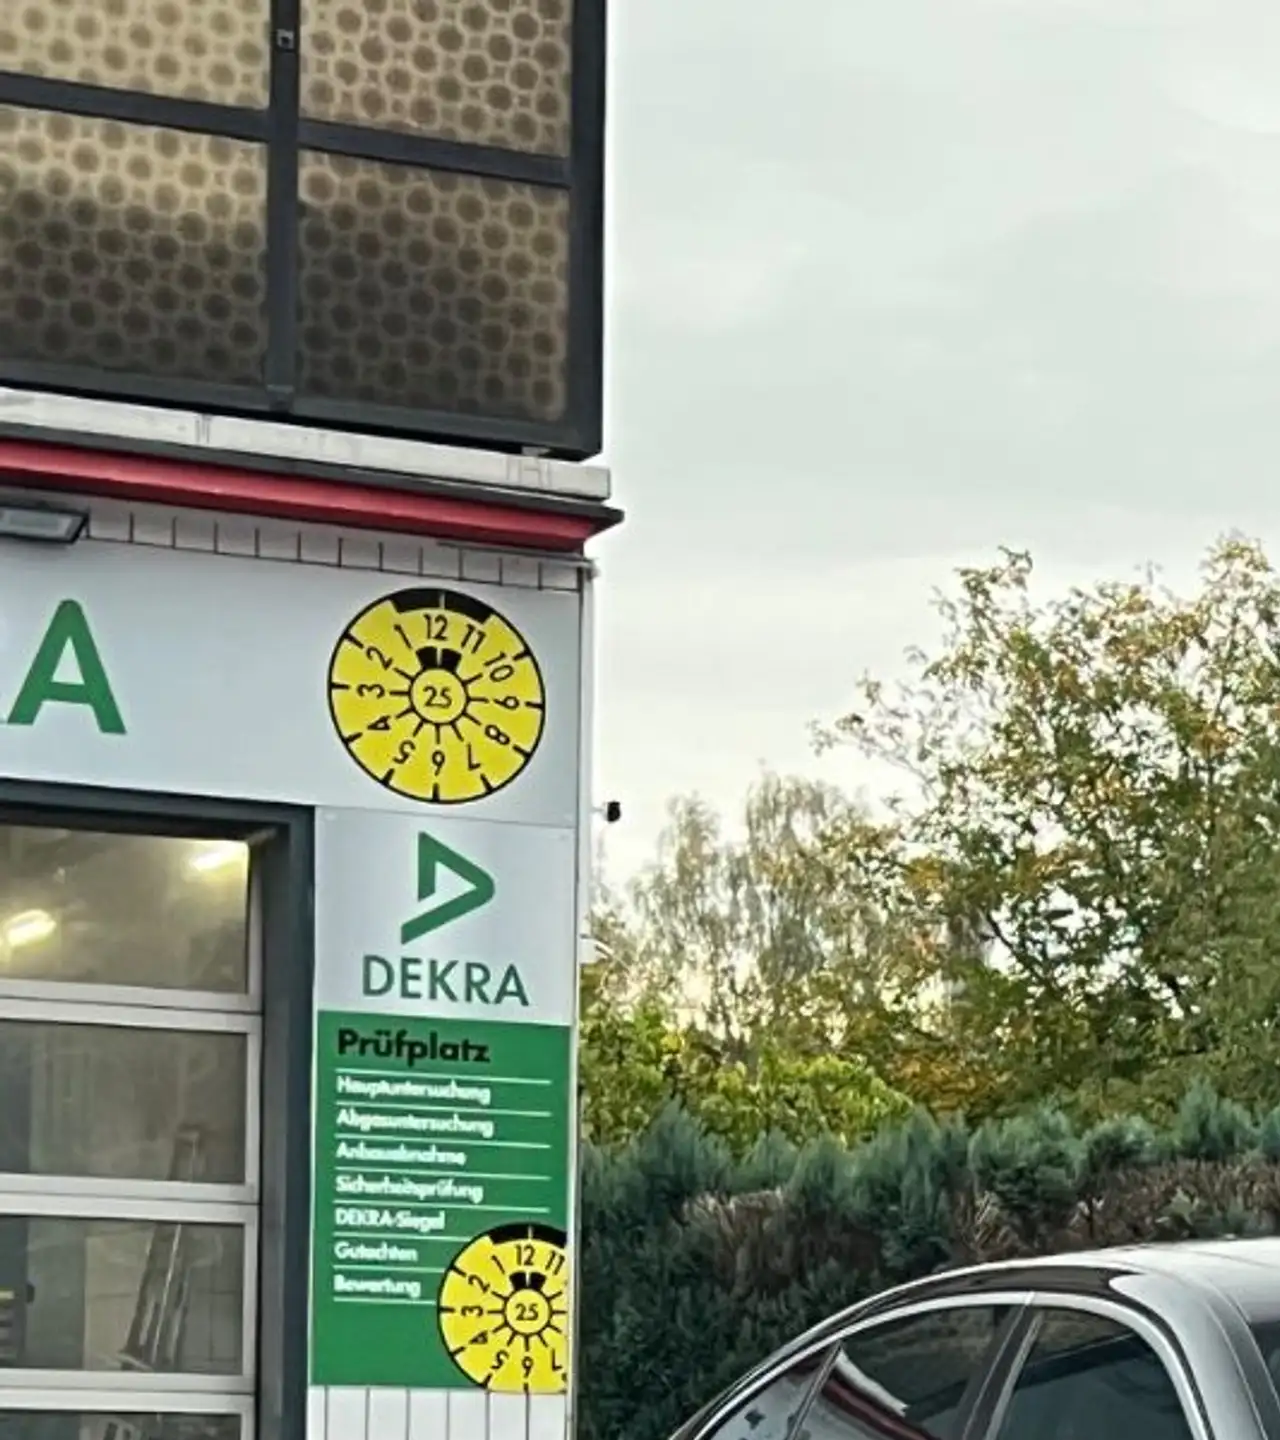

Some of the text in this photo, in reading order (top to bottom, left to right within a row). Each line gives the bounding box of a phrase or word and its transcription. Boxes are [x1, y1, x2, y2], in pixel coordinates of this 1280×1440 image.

[394, 624, 413, 649] 1
[424, 614, 448, 640] 12
[461, 624, 486, 654] 11
[0, 598, 127, 734] A
[366, 647, 393, 670] 2
[484, 652, 514, 682] 10
[357, 684, 385, 699] 3
[423, 686, 452, 708] 25
[493, 696, 519, 709] 9
[367, 715, 391, 730] 4
[484, 725, 510, 745] 8
[392, 740, 416, 764] 5
[466, 743, 480, 770] 7
[363, 954, 529, 1006] DEKRA
[338, 1028, 491, 1067] Prüfplatz
[336, 1075, 491, 1105] Hauptuntersuchung
[336, 1108, 494, 1138] Abgasuntersuchung
[335, 1174, 484, 1204] Sicherheitsprüfung
[335, 1208, 446, 1233] DEKRA-Siegel
[334, 1241, 419, 1262] Gutachten
[515, 1244, 536, 1266] 12
[545, 1250, 565, 1275] 11
[333, 1274, 422, 1298] Bewertung
[468, 1274, 490, 1293] 2
[461, 1306, 484, 1317] 3
[514, 1303, 538, 1321] 25
